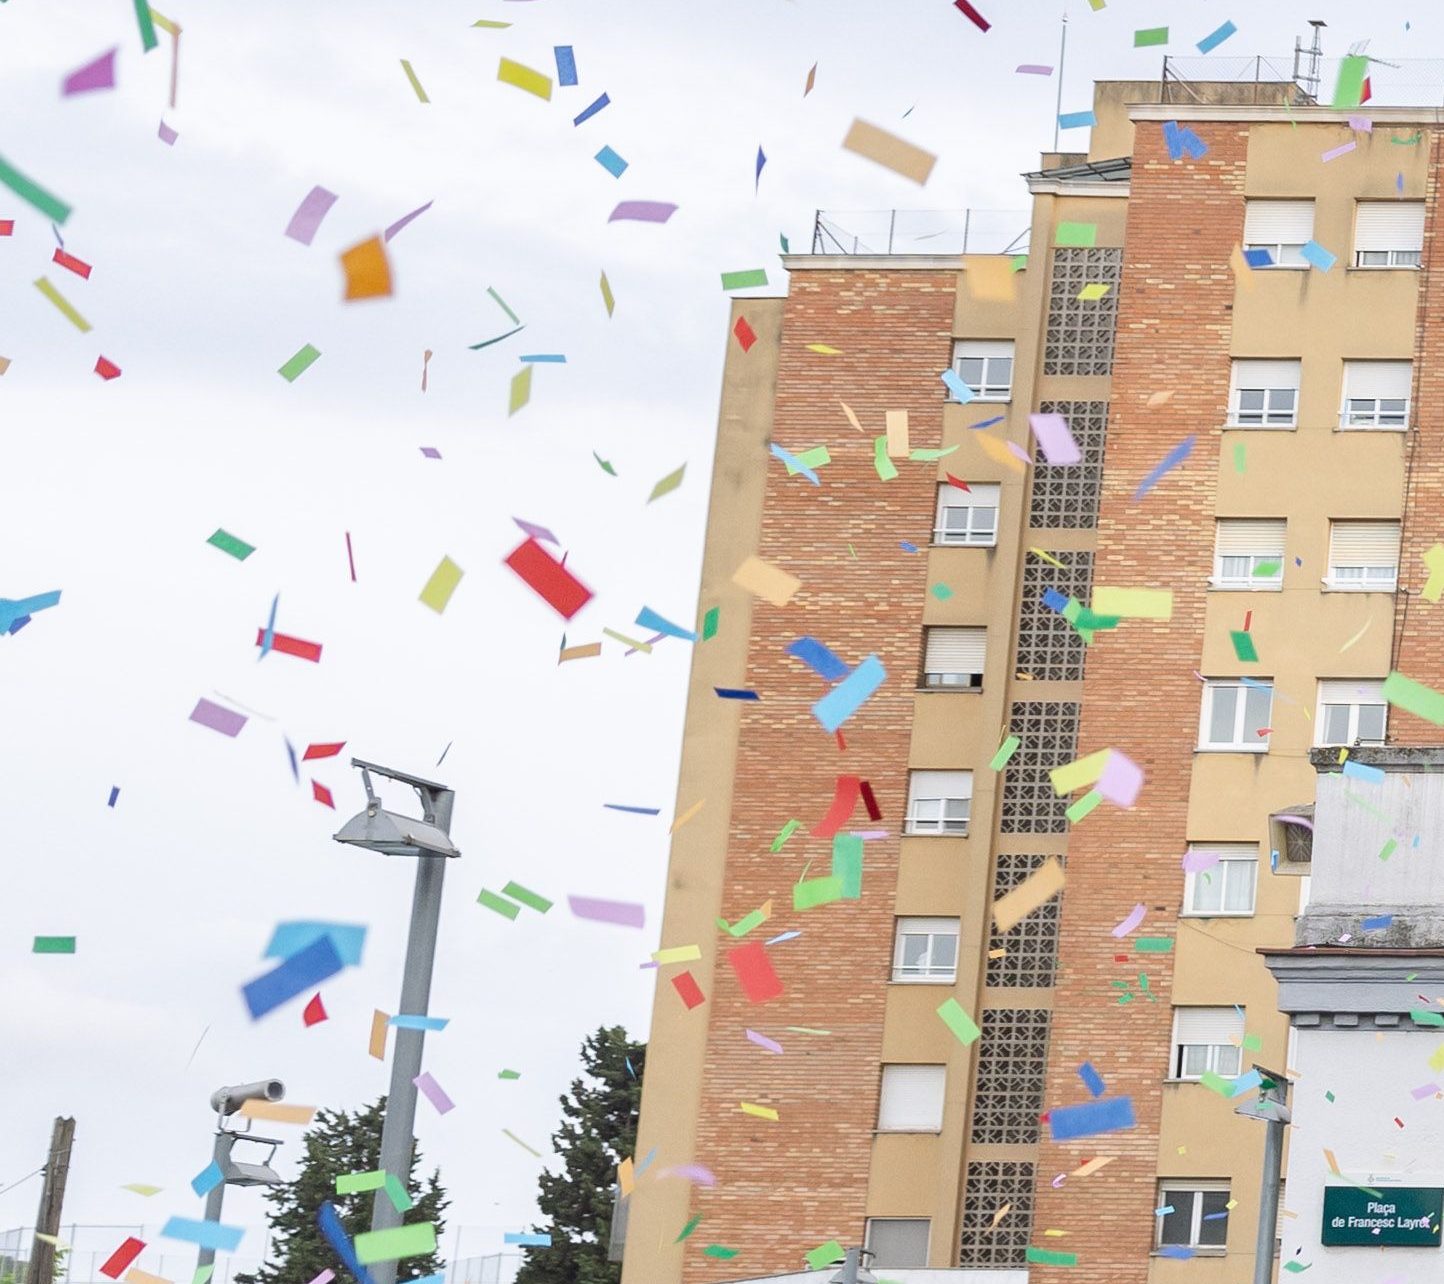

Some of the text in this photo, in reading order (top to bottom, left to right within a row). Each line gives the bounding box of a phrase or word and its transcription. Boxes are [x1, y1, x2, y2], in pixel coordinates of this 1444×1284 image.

[1367, 1202, 1396, 1216] Plaça
[1331, 1217, 1345, 1228] de
[1347, 1217, 1395, 1228] Francesc
